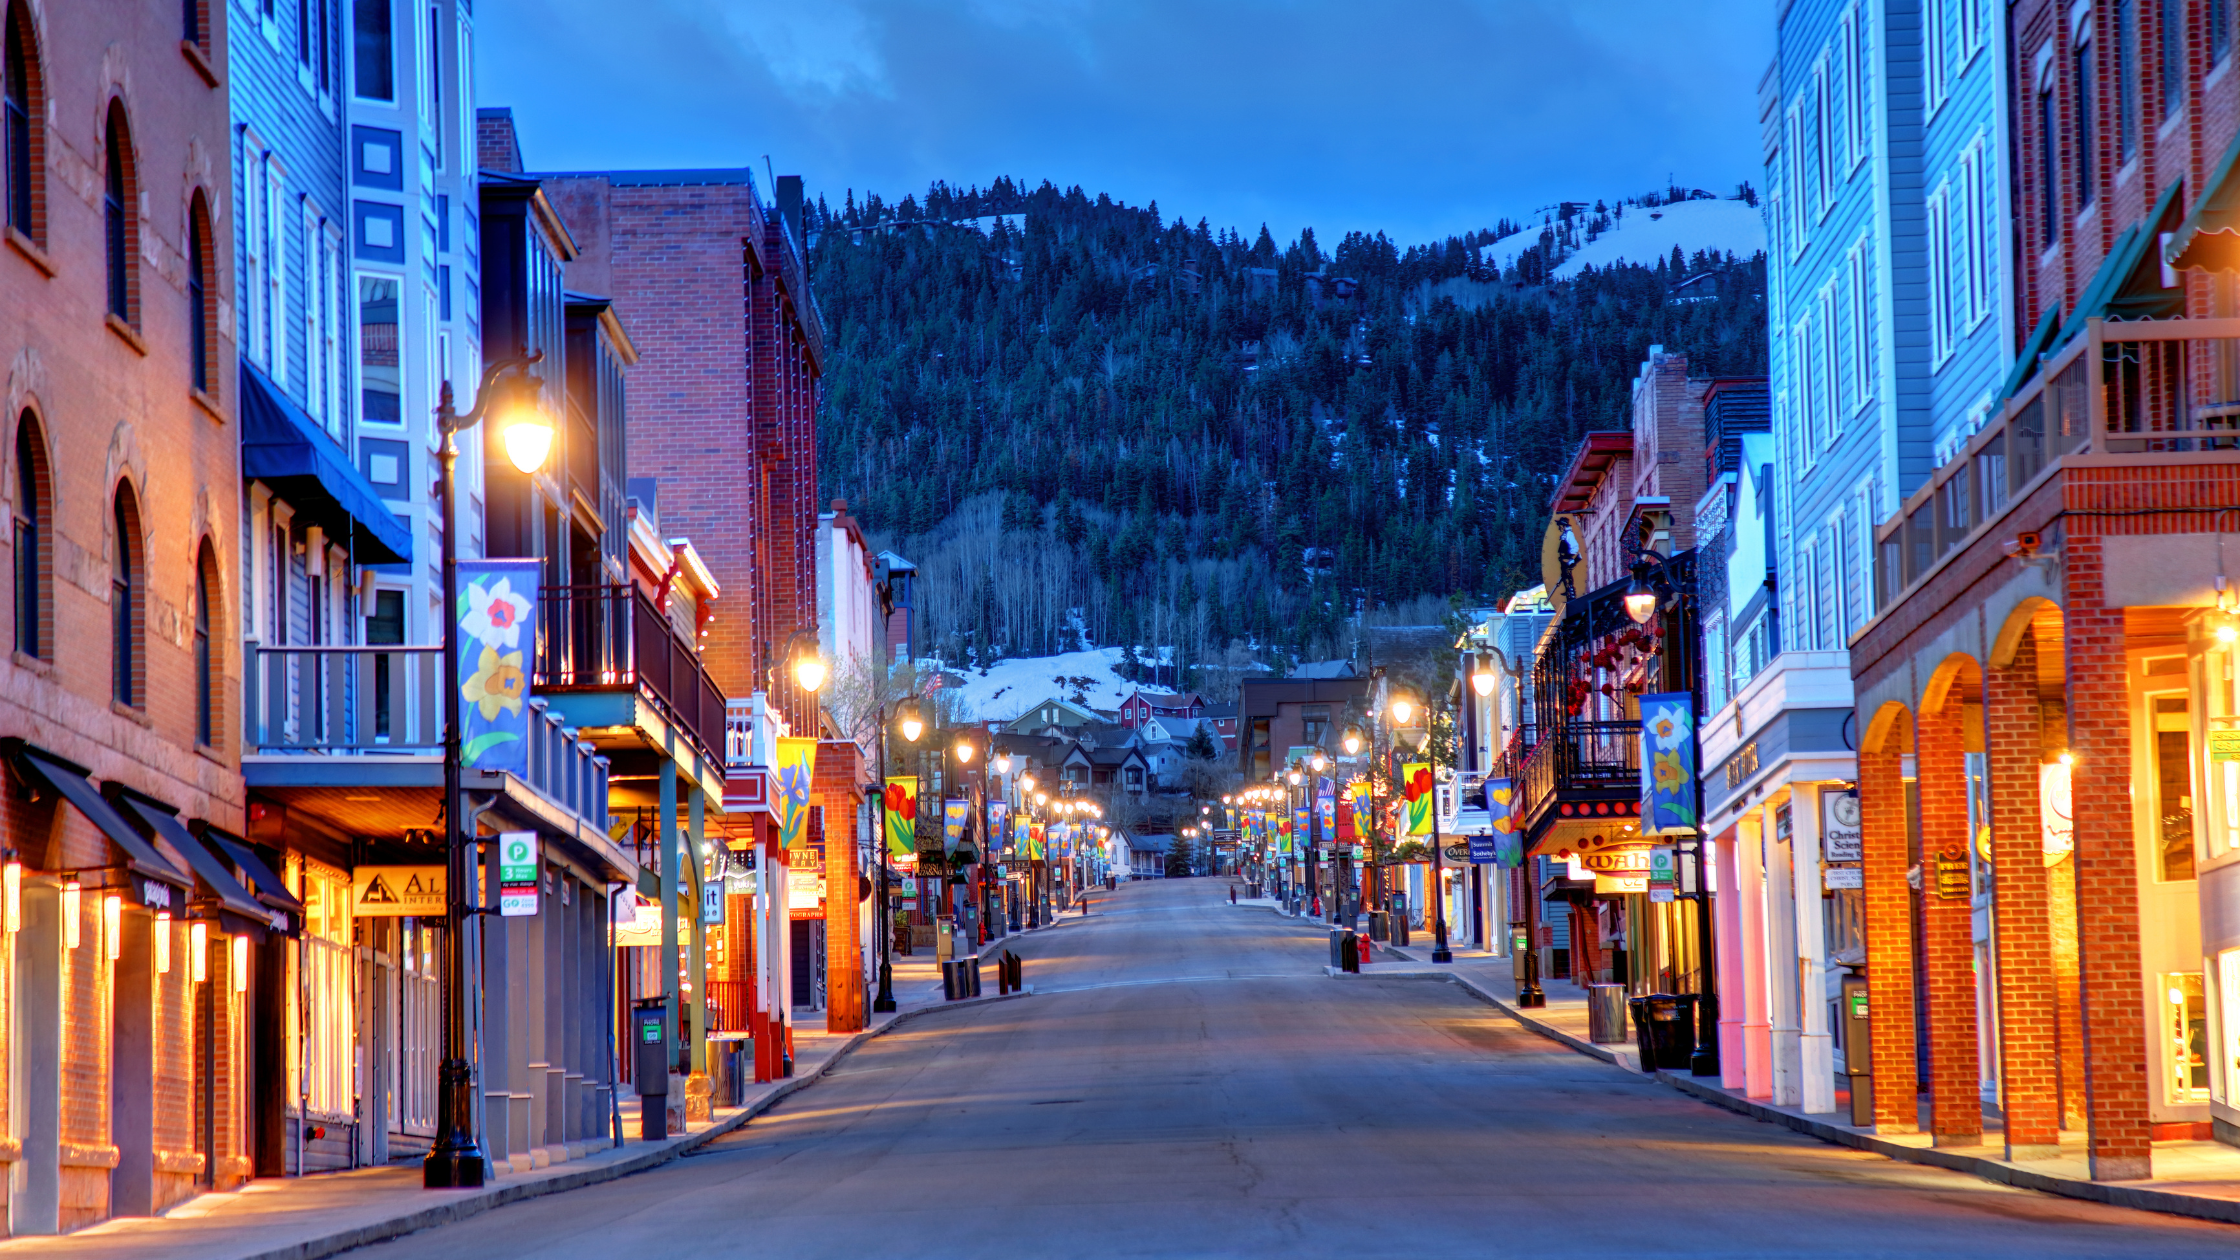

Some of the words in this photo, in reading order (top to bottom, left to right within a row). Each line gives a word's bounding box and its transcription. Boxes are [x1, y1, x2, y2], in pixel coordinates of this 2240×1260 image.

[1829, 830, 1860, 840] Christ
[1834, 841, 1860, 849] Scien
[1448, 847, 1470, 856] OVER
[1940, 862, 1968, 870] FREE
[403, 873, 446, 893] AL
